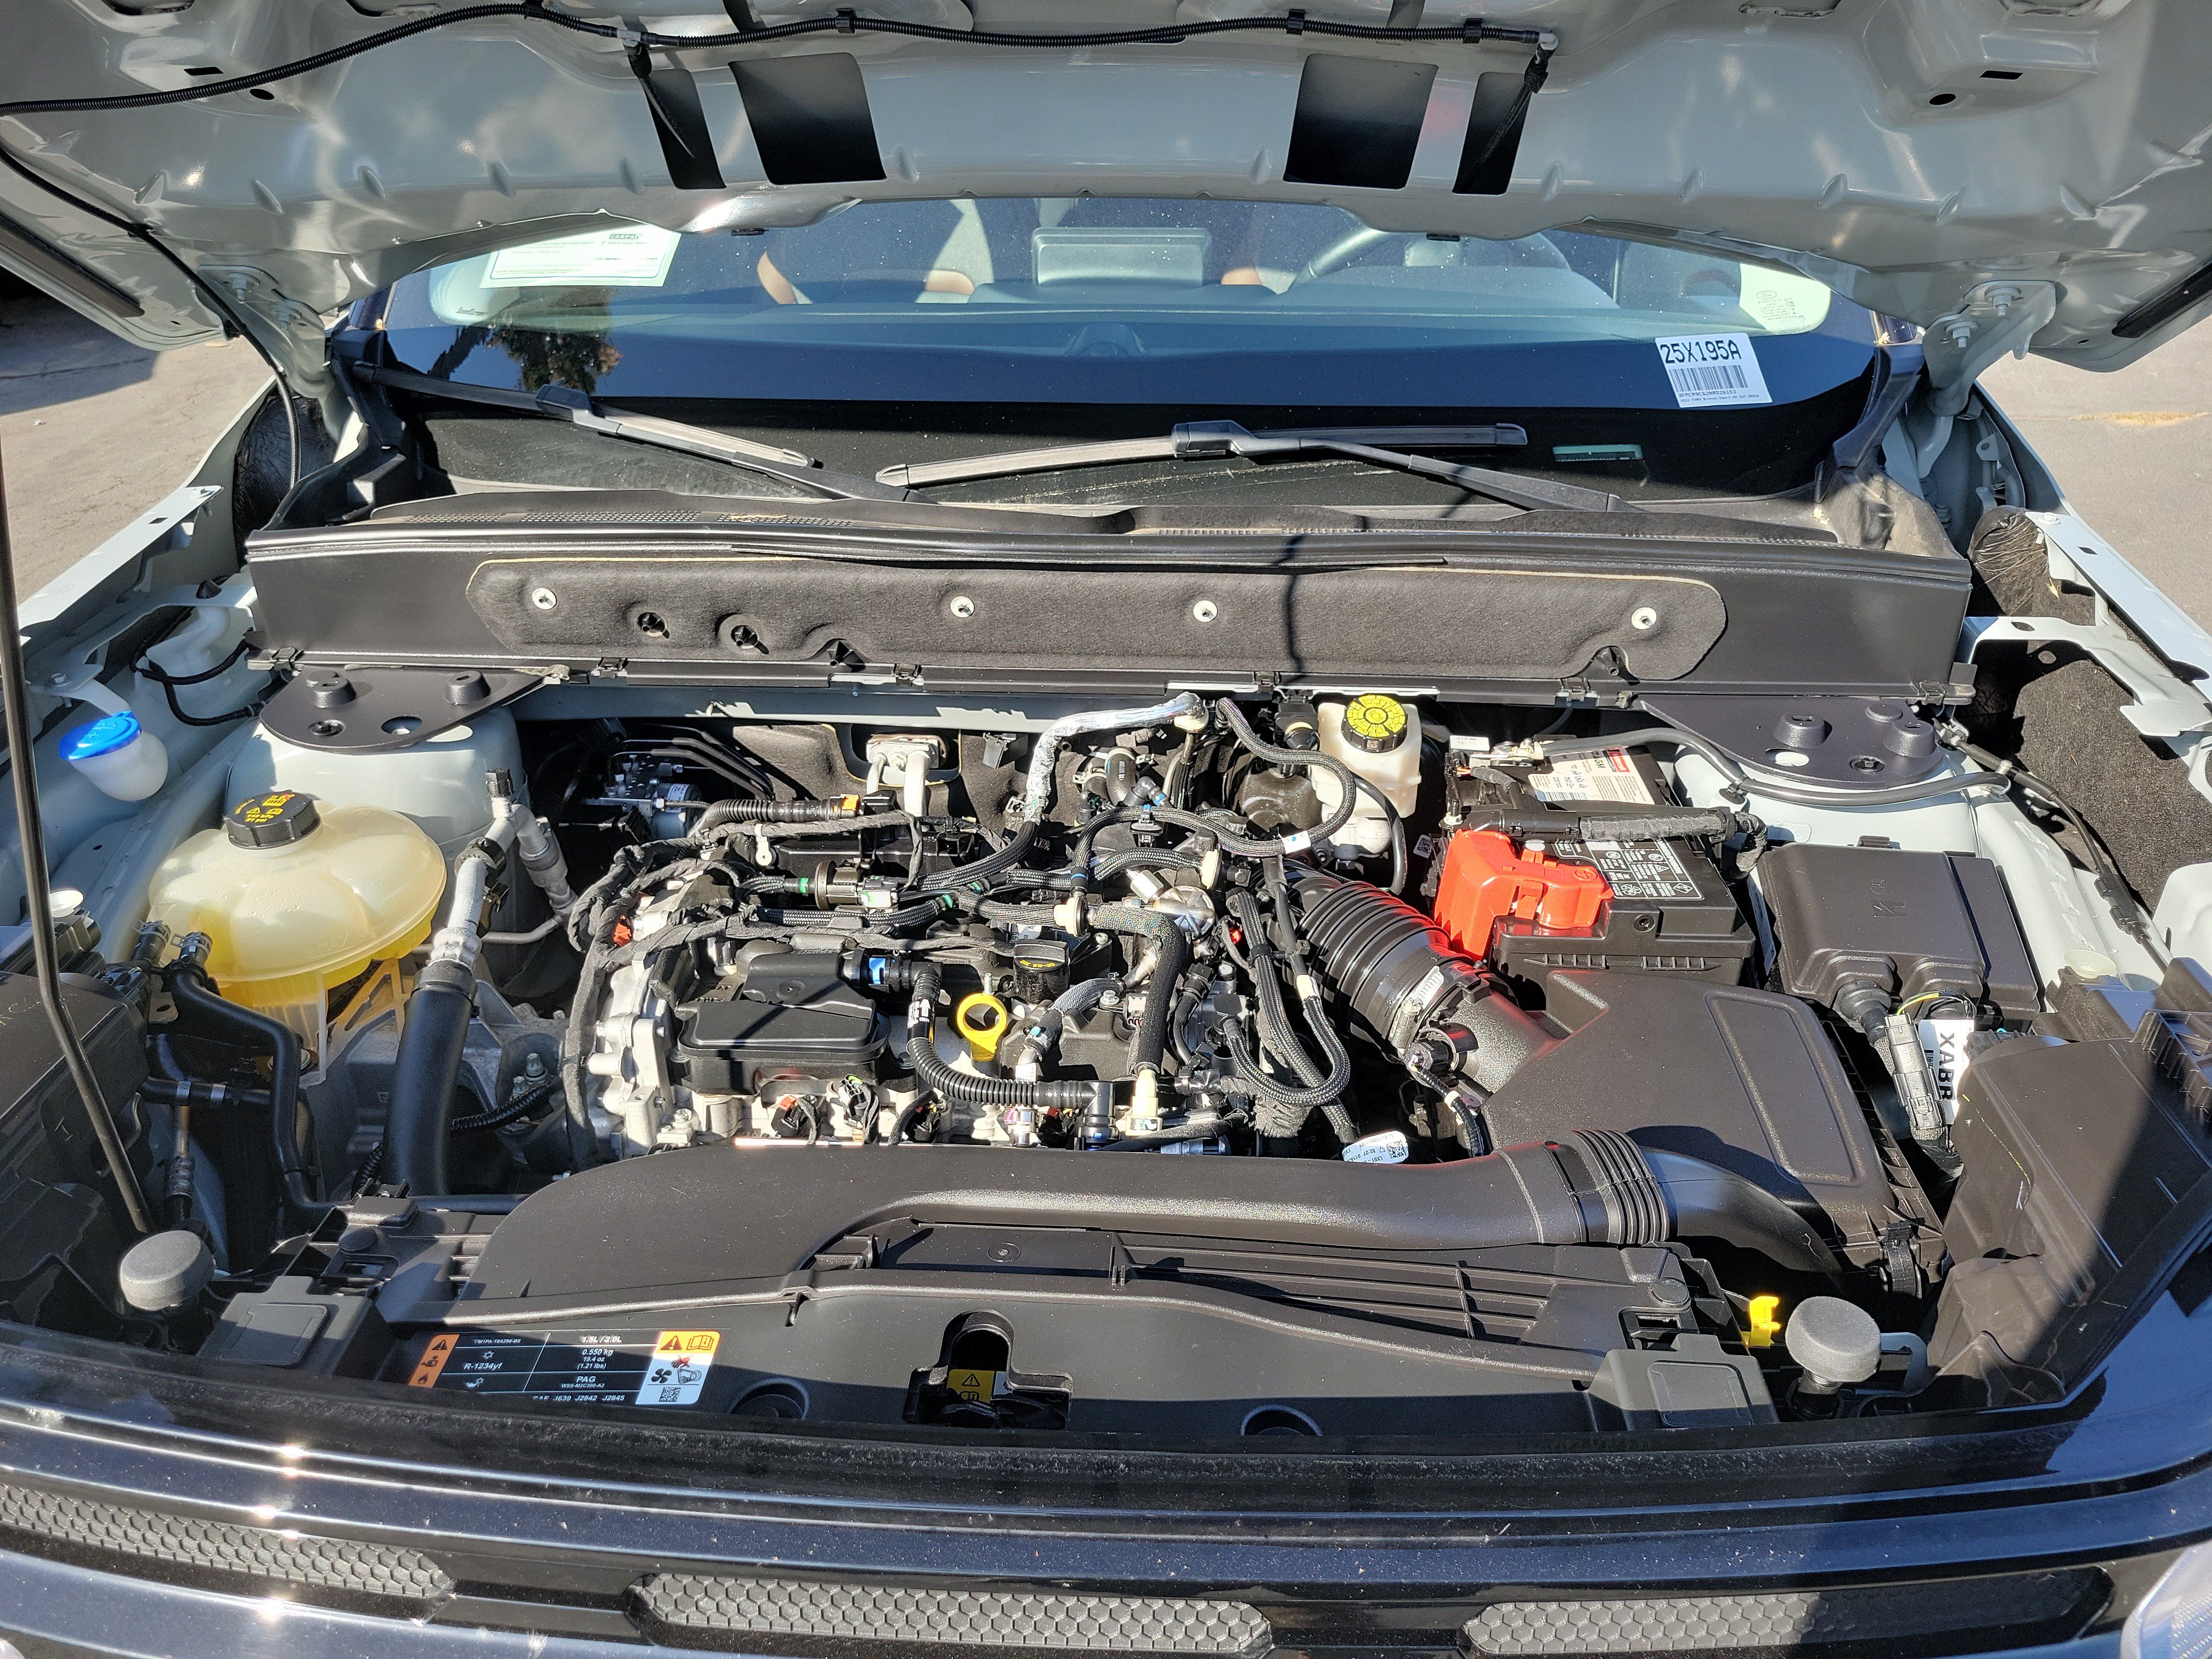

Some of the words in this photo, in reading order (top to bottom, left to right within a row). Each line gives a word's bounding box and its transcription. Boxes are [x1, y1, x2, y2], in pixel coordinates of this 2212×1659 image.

[1660, 340, 1742, 364] 25X195A
[1938, 1032, 1955, 1100] XABR
[464, 1362, 504, 1370] R-1234yf
